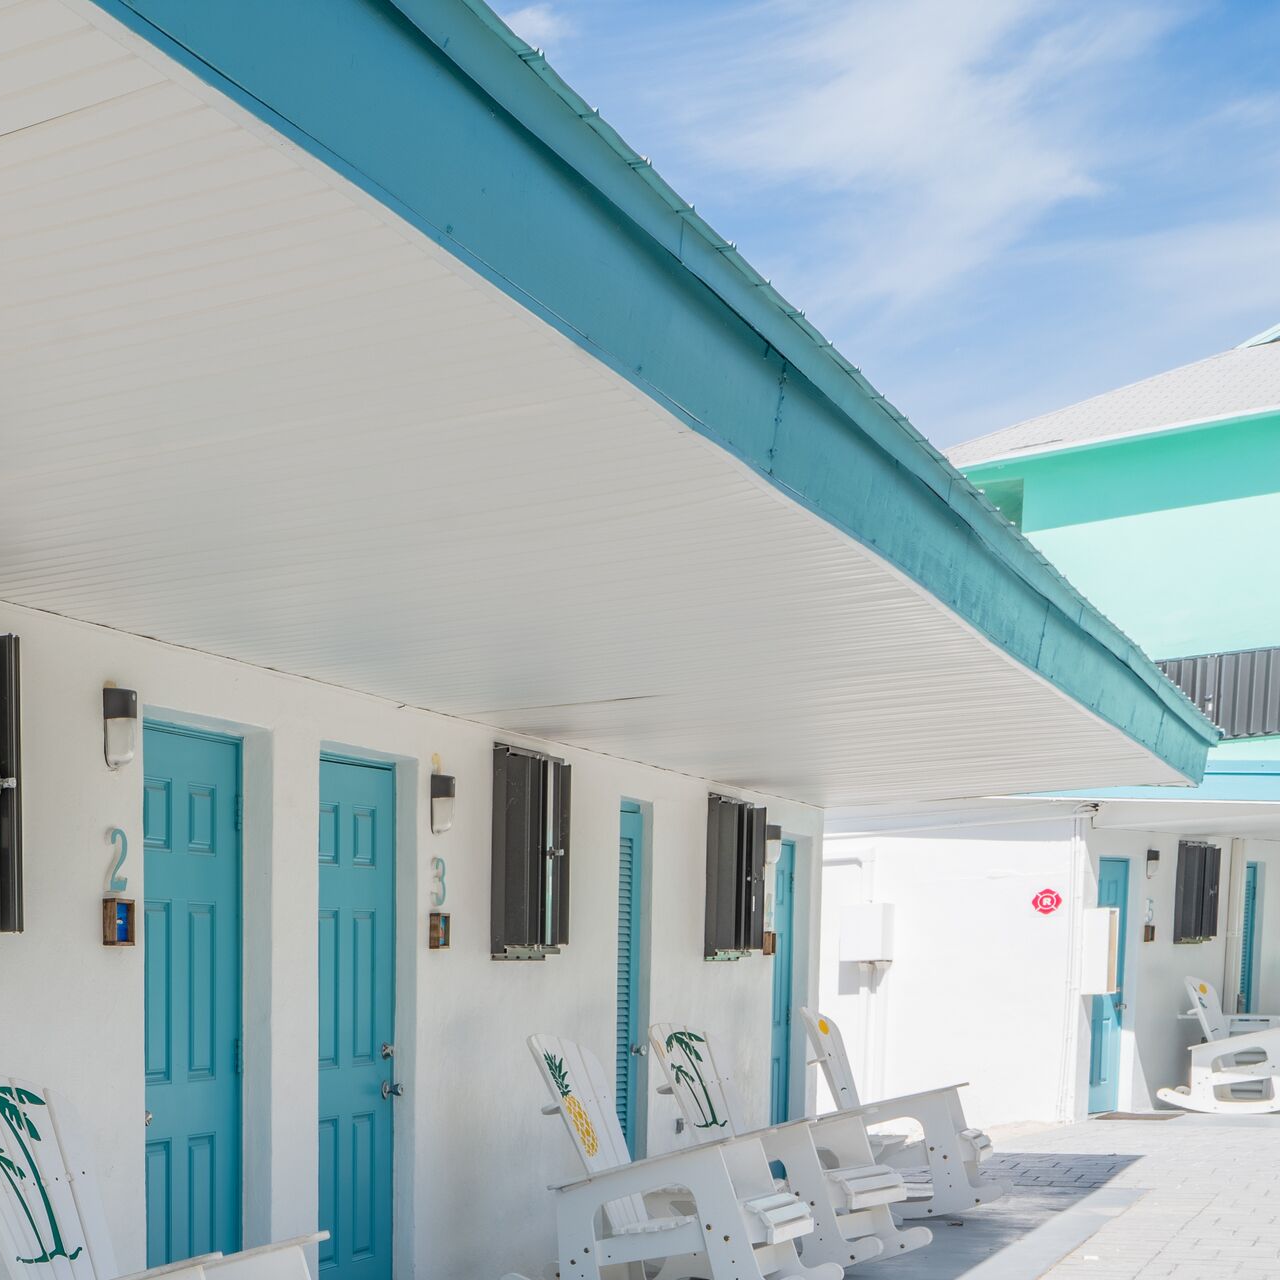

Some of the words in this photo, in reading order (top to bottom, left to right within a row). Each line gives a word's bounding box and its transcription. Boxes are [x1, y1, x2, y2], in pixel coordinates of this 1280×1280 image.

[108, 827, 128, 892] 2
[433, 857, 446, 906] 3
[1042, 897, 1052, 906] R
